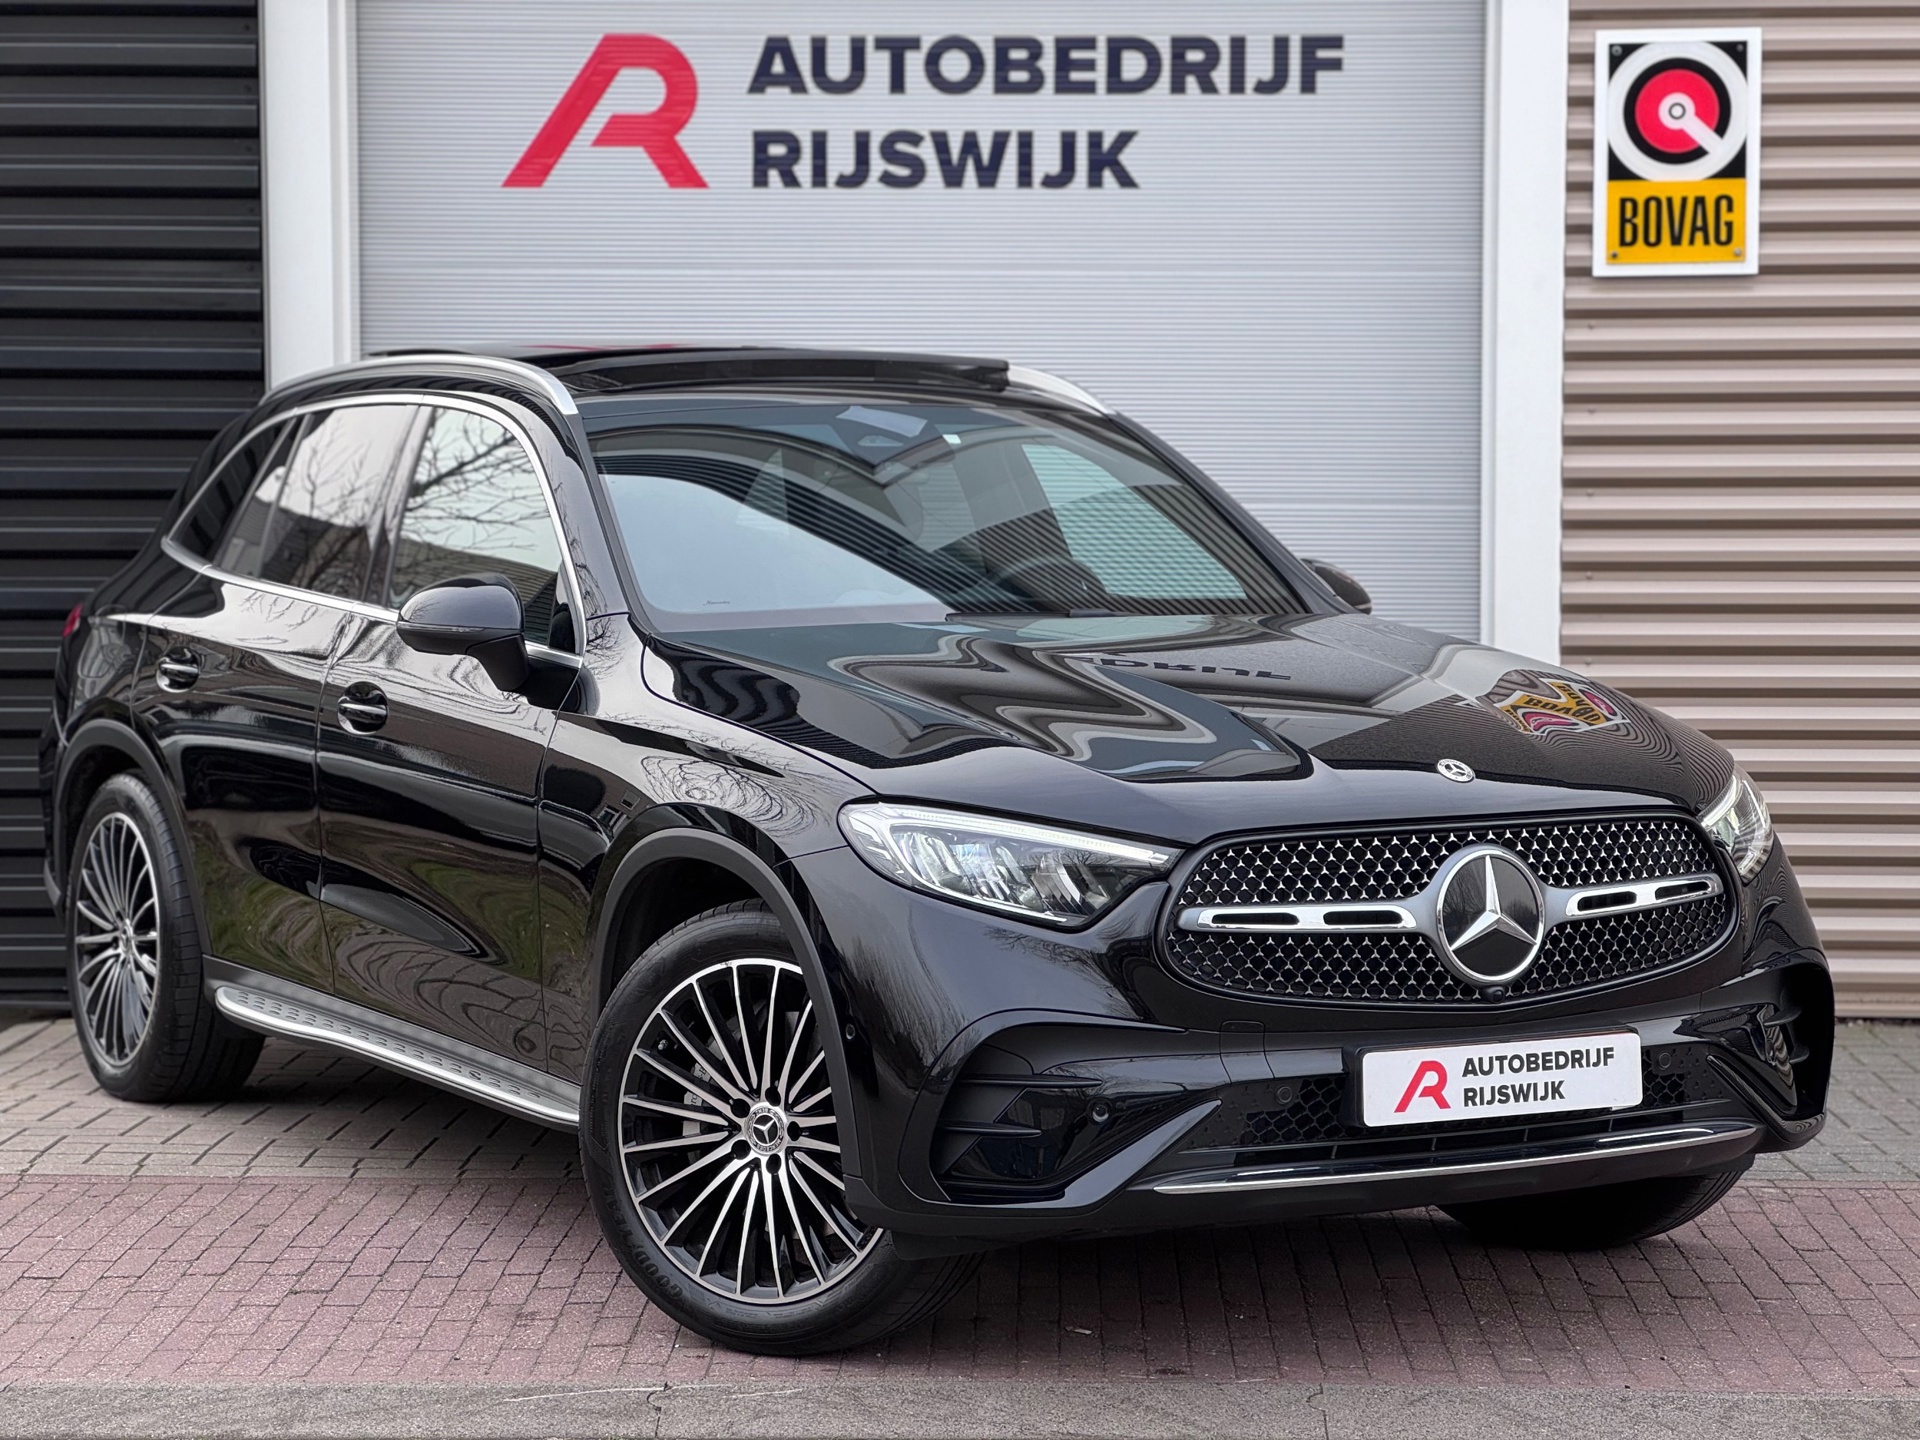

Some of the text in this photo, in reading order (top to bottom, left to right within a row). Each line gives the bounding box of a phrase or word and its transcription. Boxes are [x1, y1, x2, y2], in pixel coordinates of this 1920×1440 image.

[747, 35, 1344, 96] AUTOBEDRIJF
[752, 129, 1139, 190] RIJSWIJK
[1619, 194, 1734, 248] BOVAG
[1462, 1047, 1615, 1077] AUTOBEDRIJF
[1463, 1081, 1565, 1107] RIJSWIJK
[602, 1186, 684, 1300] GOODYEAR
